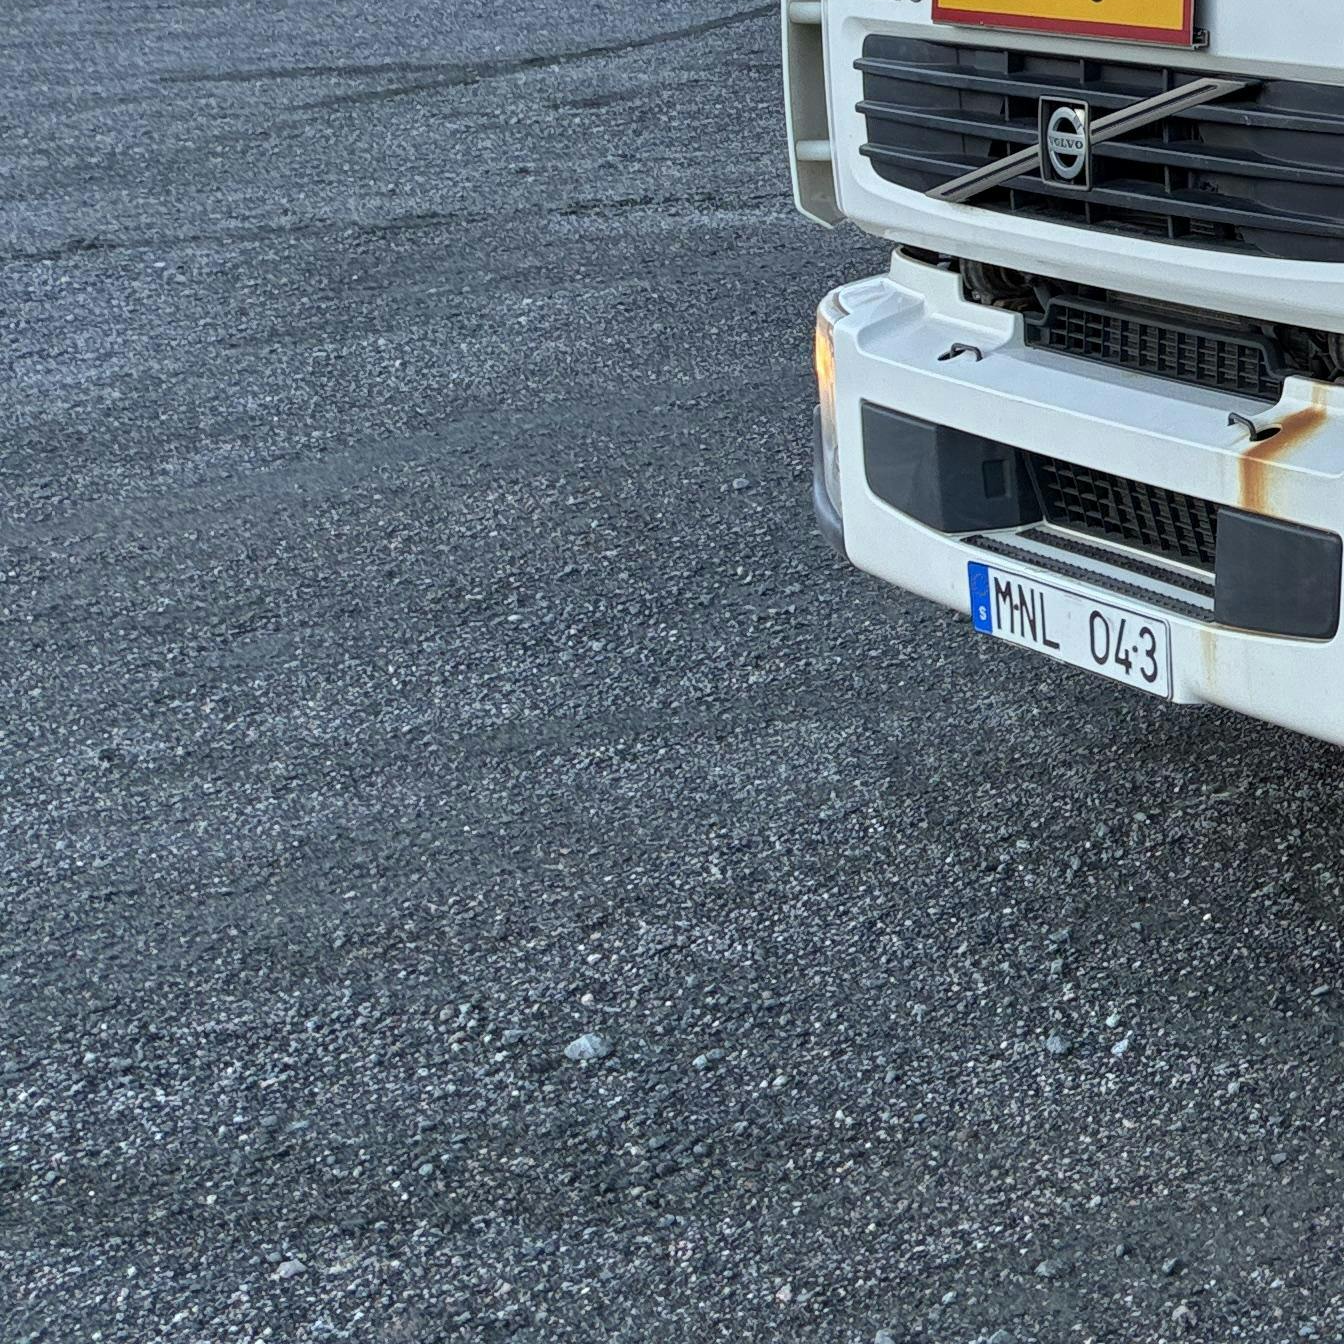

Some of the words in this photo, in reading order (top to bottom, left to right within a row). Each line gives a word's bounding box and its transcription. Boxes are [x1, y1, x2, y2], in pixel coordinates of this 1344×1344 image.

[1048, 136, 1084, 150] VOLVO
[979, 605, 987, 621] S
[994, 576, 1061, 651] MNL
[1089, 609, 1158, 684] 043
